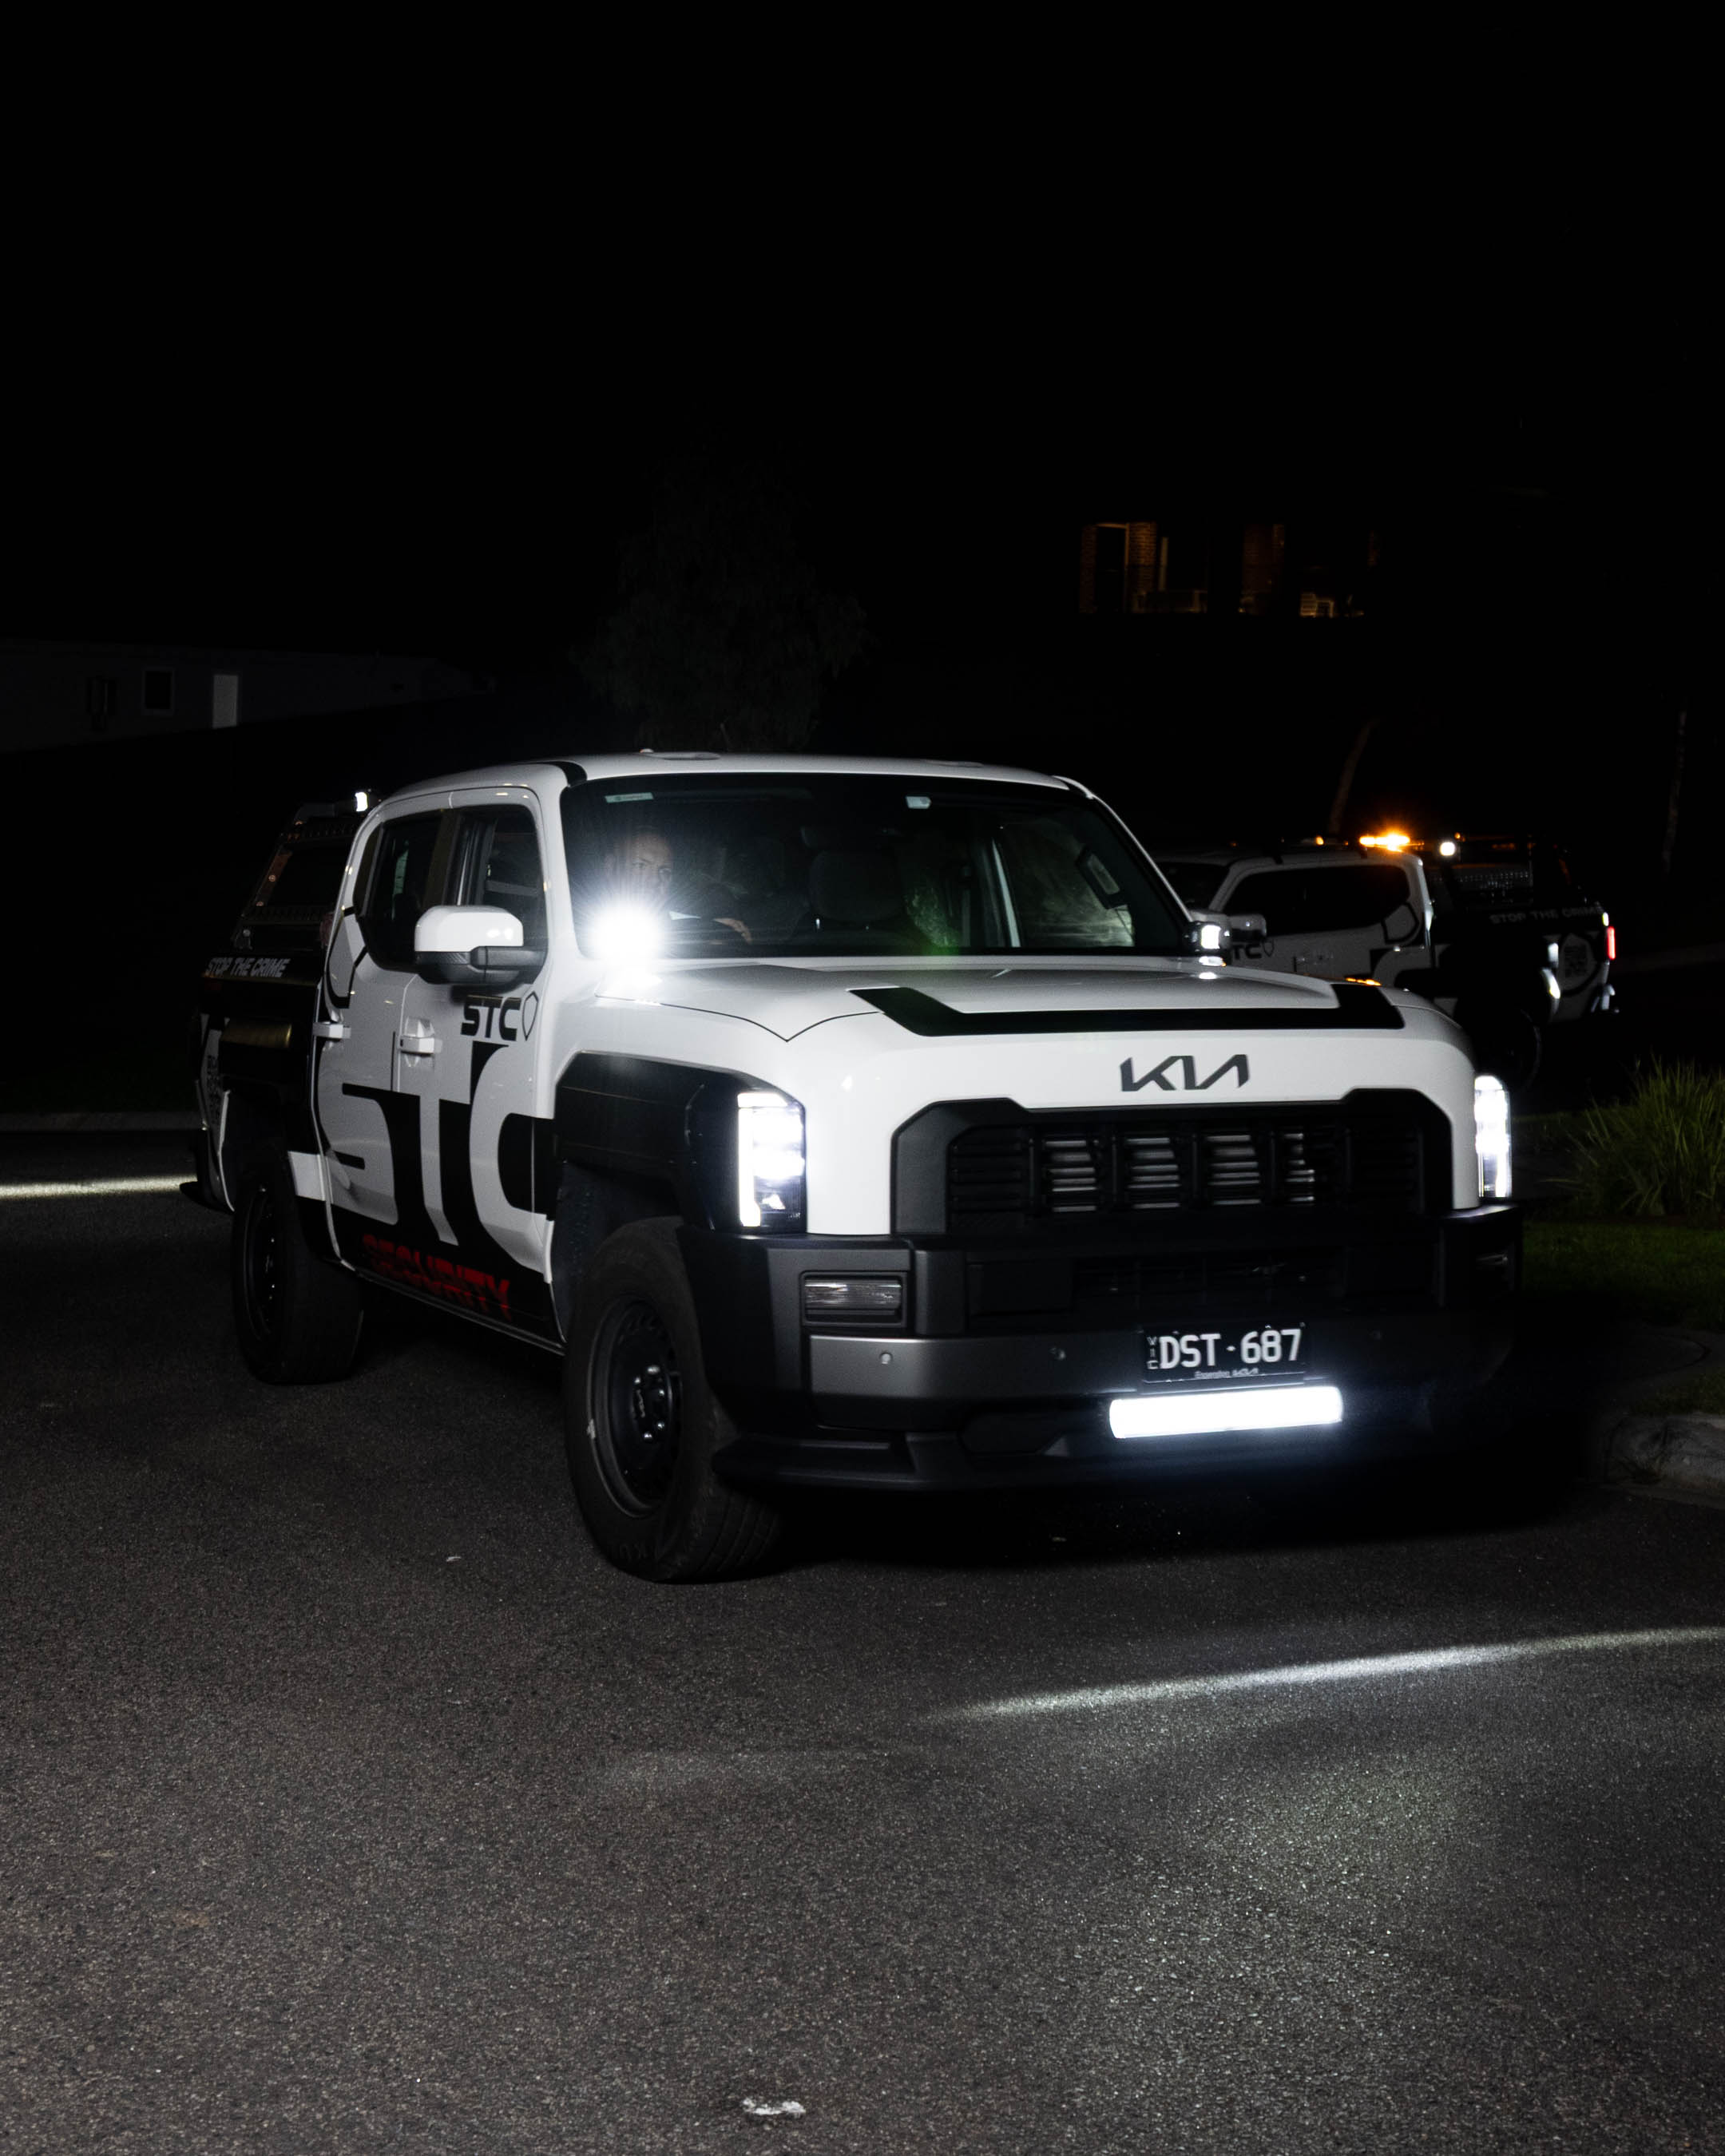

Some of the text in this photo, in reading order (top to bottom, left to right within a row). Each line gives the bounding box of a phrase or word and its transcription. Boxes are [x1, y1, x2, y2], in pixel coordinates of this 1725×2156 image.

[204, 957, 291, 978] STOP THE CRIME
[461, 997, 521, 1041] STC
[1120, 1054, 1251, 1092] KIA
[360, 1232, 512, 1324] SECURITY
